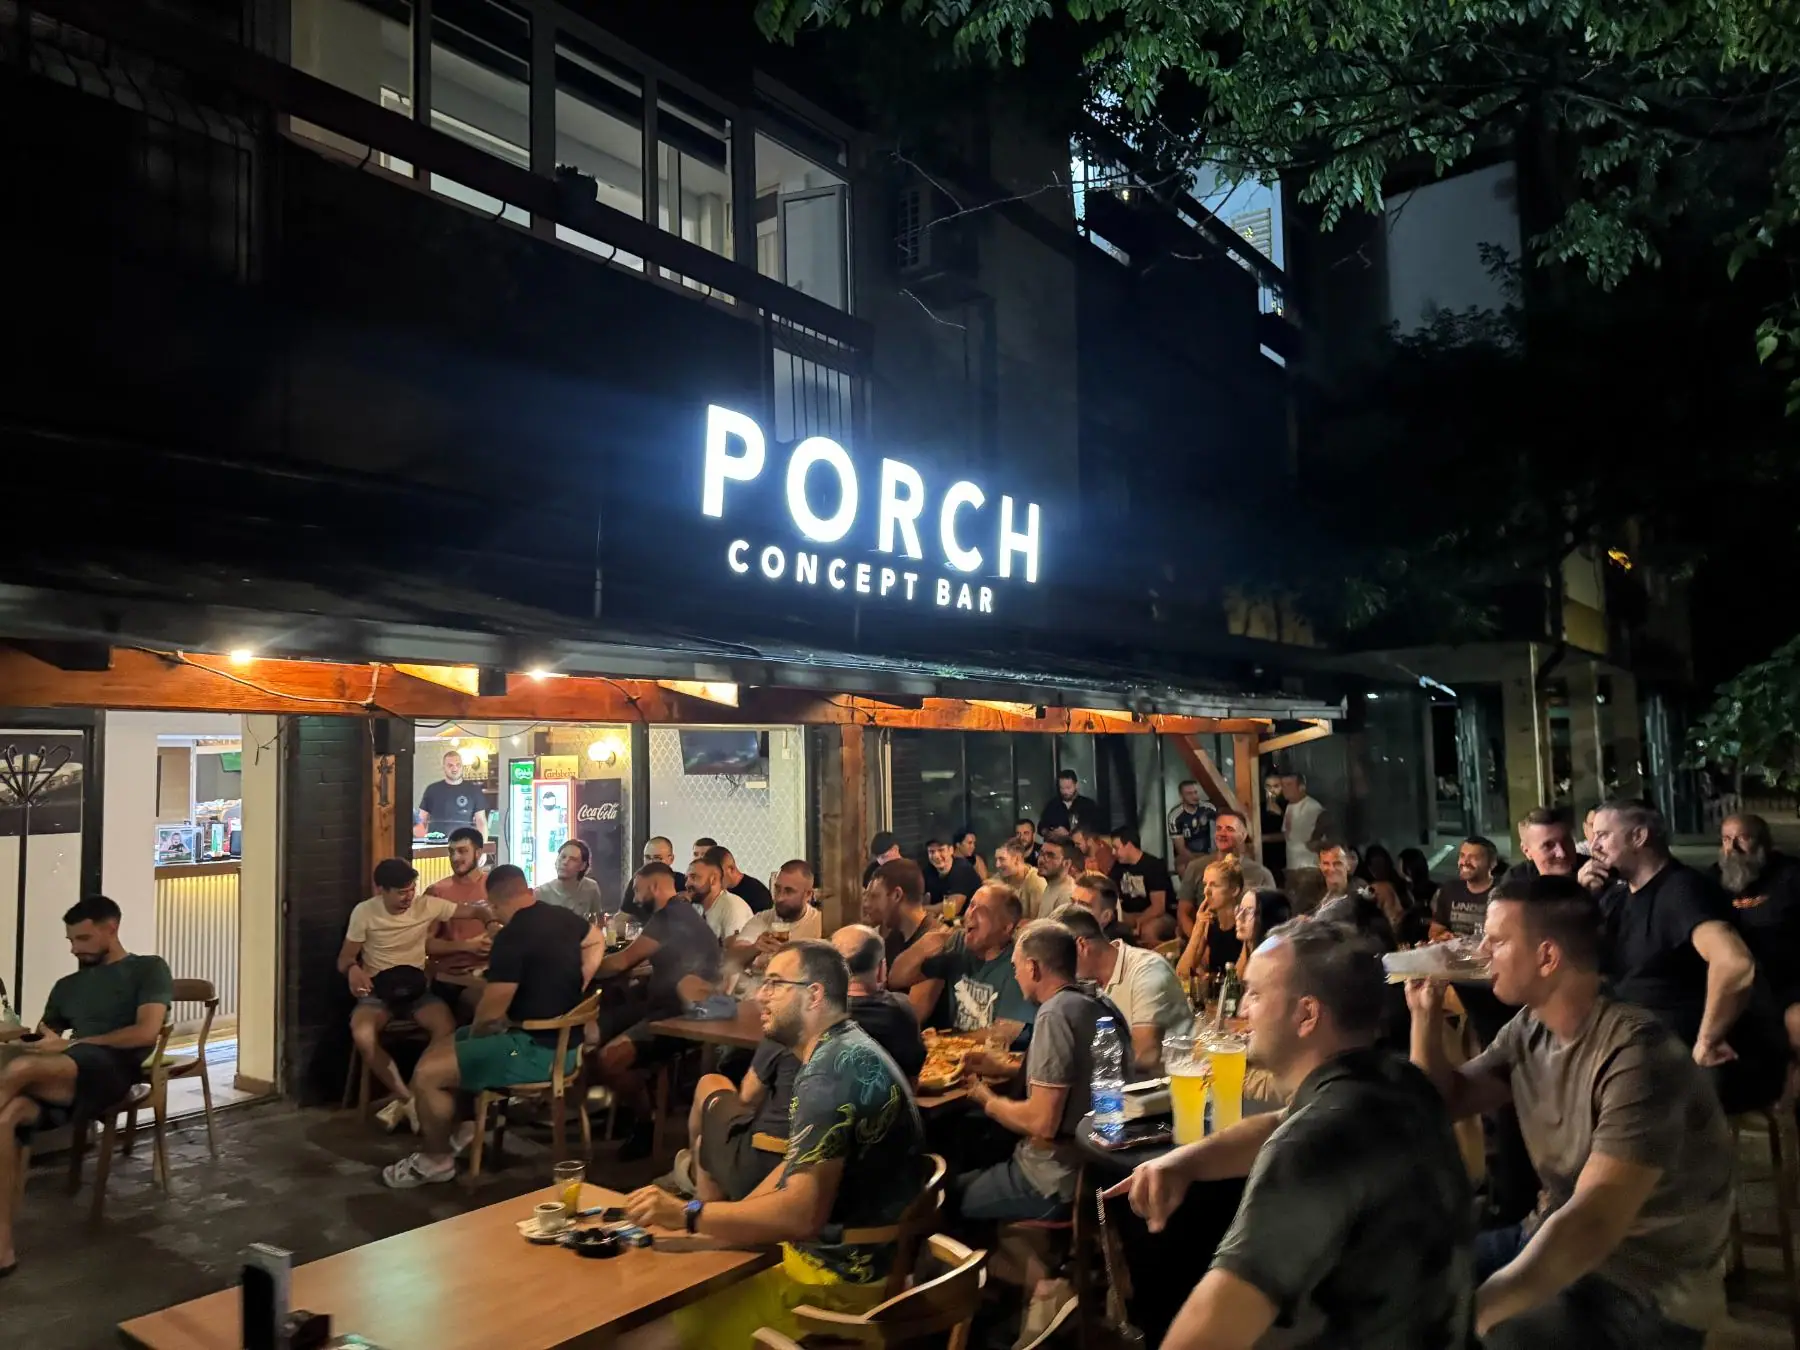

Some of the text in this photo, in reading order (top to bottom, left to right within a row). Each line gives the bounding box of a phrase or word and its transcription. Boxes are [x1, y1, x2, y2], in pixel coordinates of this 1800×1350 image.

[702, 403, 1040, 584] PORCH
[727, 539, 992, 613] CONCEPT BAR
